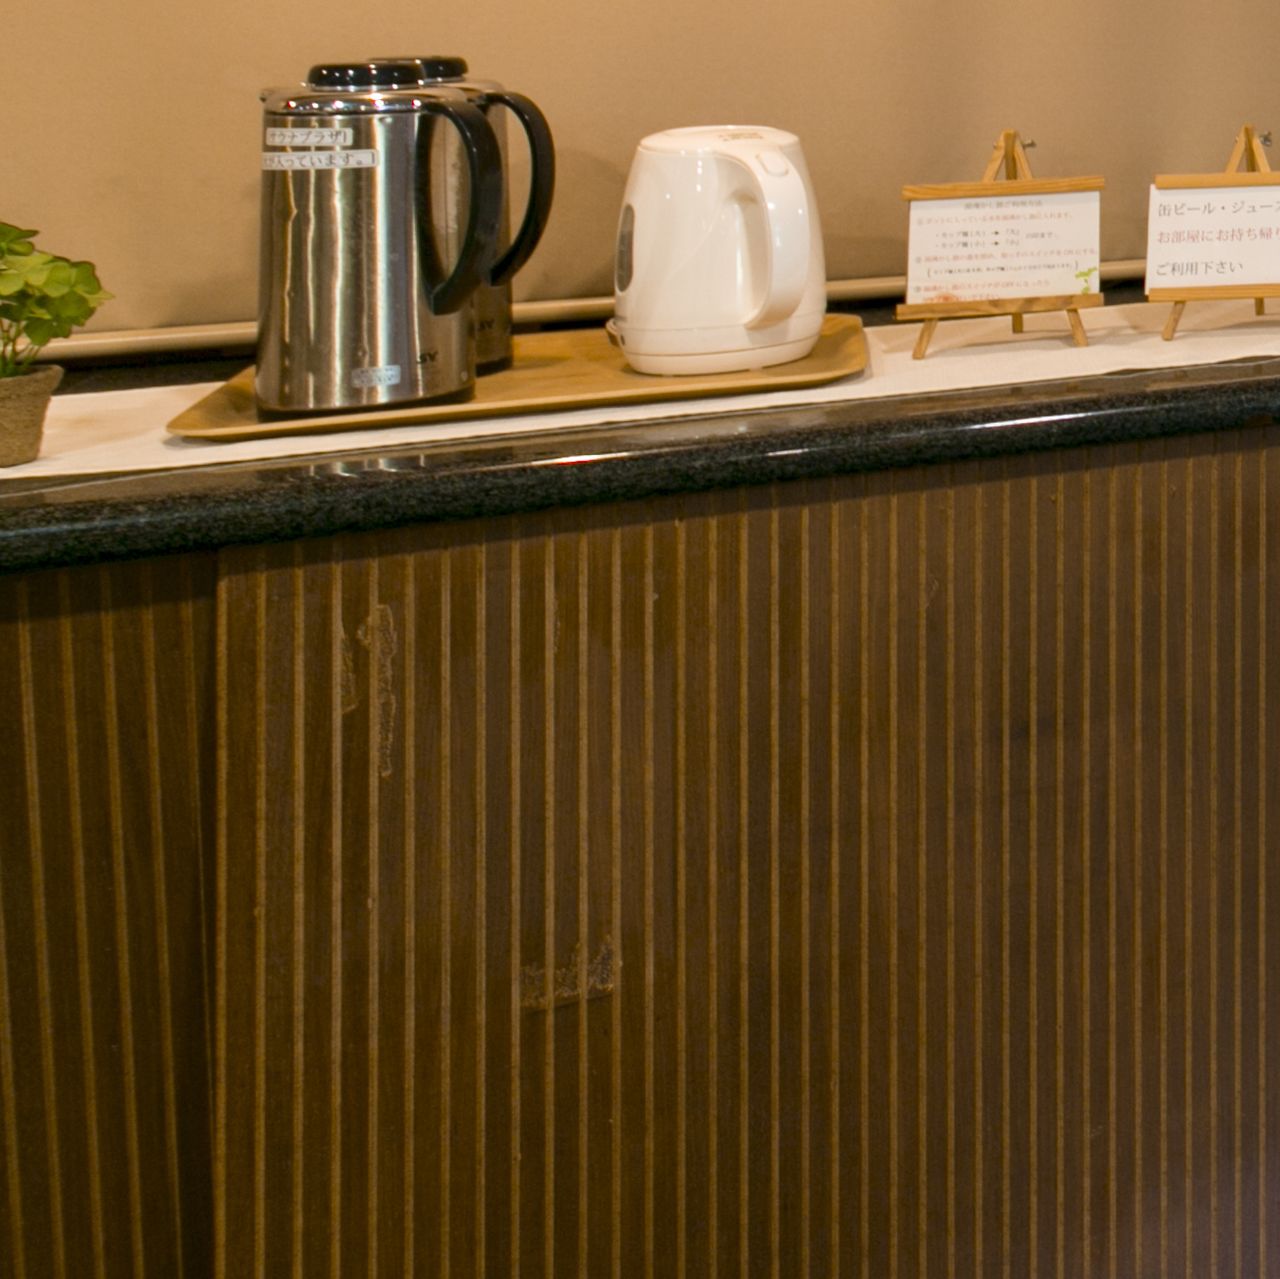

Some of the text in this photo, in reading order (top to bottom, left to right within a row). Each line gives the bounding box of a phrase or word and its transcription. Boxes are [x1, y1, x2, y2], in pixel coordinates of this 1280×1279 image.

[1156, 261, 1244, 276] ご利用下さい
